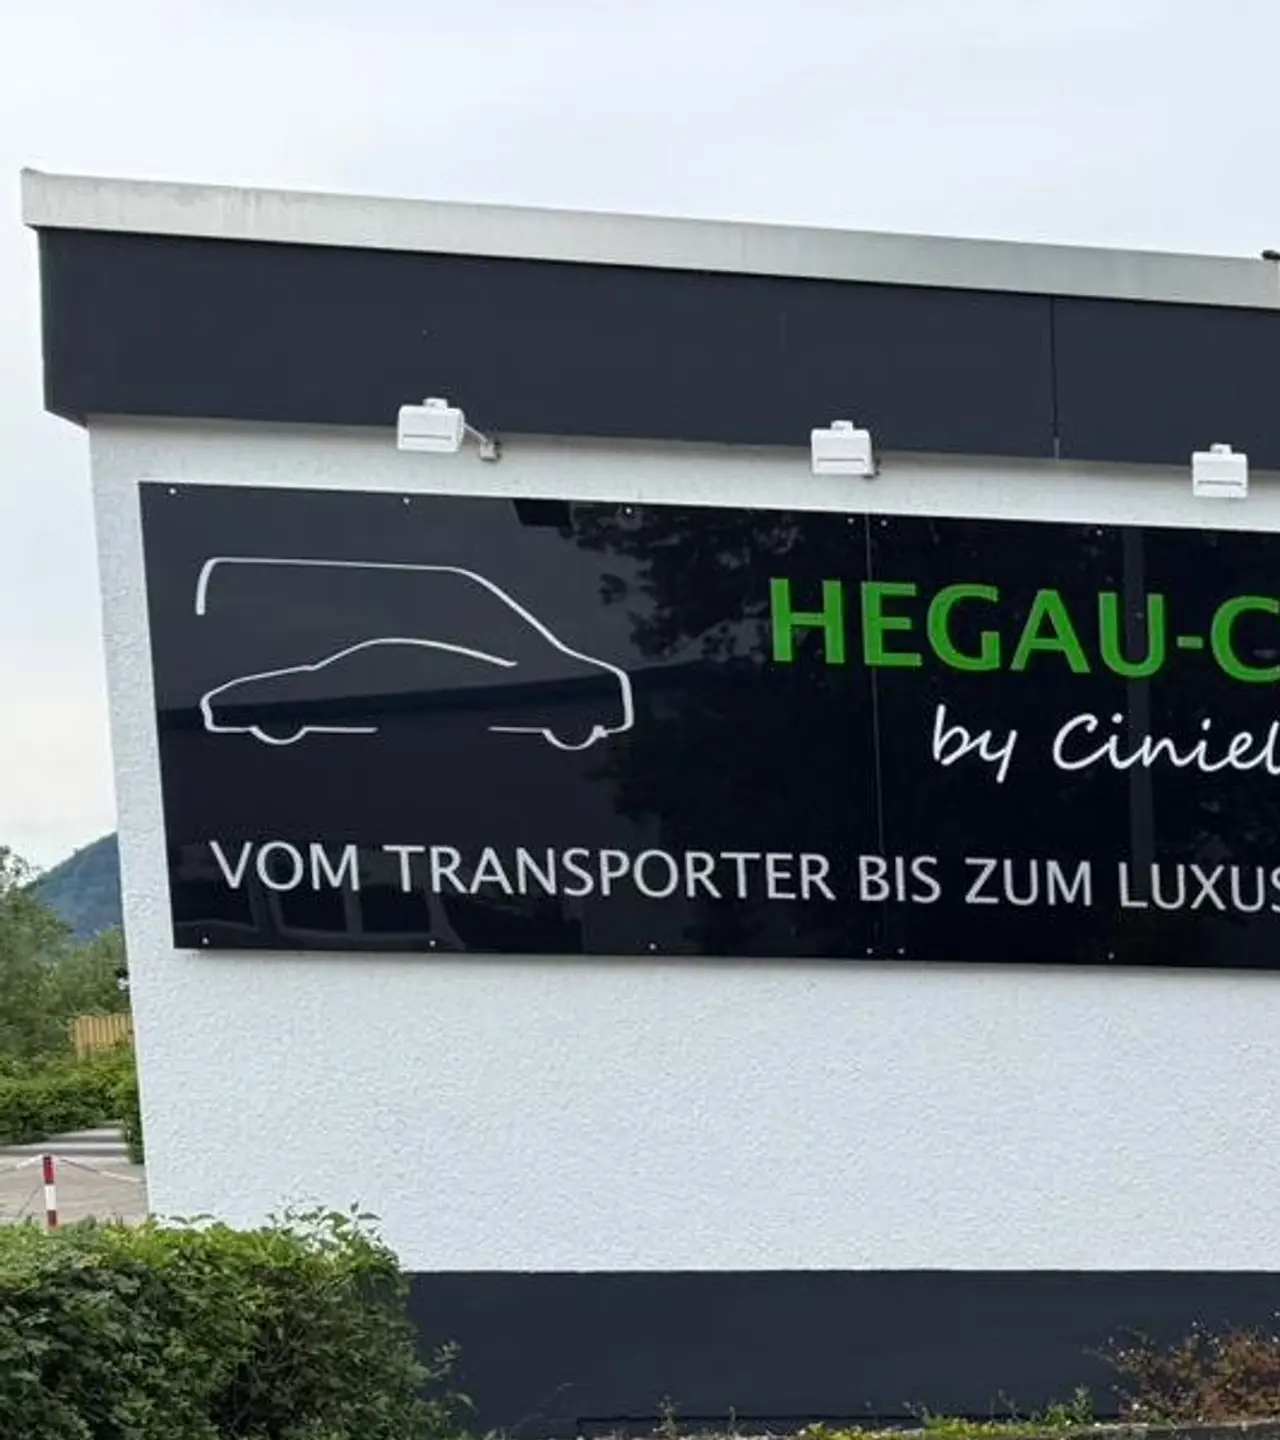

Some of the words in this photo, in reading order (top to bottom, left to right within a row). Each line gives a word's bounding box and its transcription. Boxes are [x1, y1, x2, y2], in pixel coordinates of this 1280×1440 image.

[933, 704, 1016, 783] by
[209, 840, 360, 892] VOM
[382, 844, 836, 900] TRANSPORTER
[859, 855, 941, 904] BIS
[965, 857, 1091, 906] ZUM
